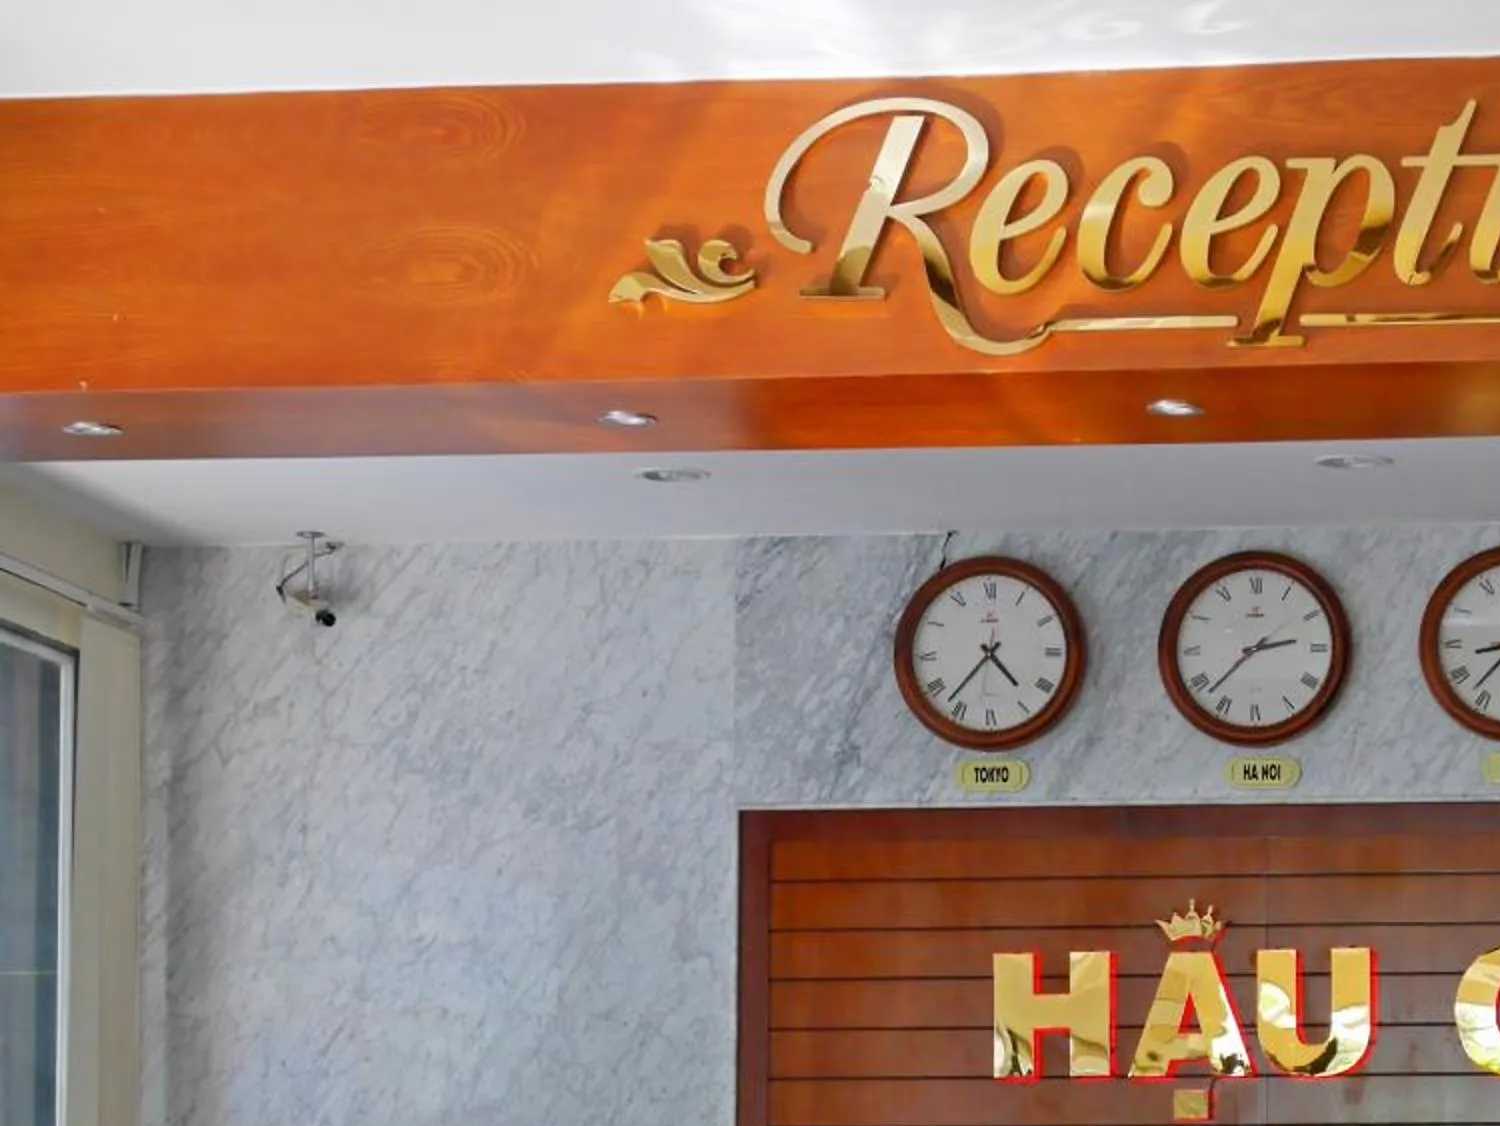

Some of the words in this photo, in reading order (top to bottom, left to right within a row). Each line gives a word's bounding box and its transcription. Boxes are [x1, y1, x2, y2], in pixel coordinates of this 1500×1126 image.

[974, 766, 1009, 784] TOKYO
[1243, 764, 1258, 781] HA
[1260, 764, 1281, 781] NOI
